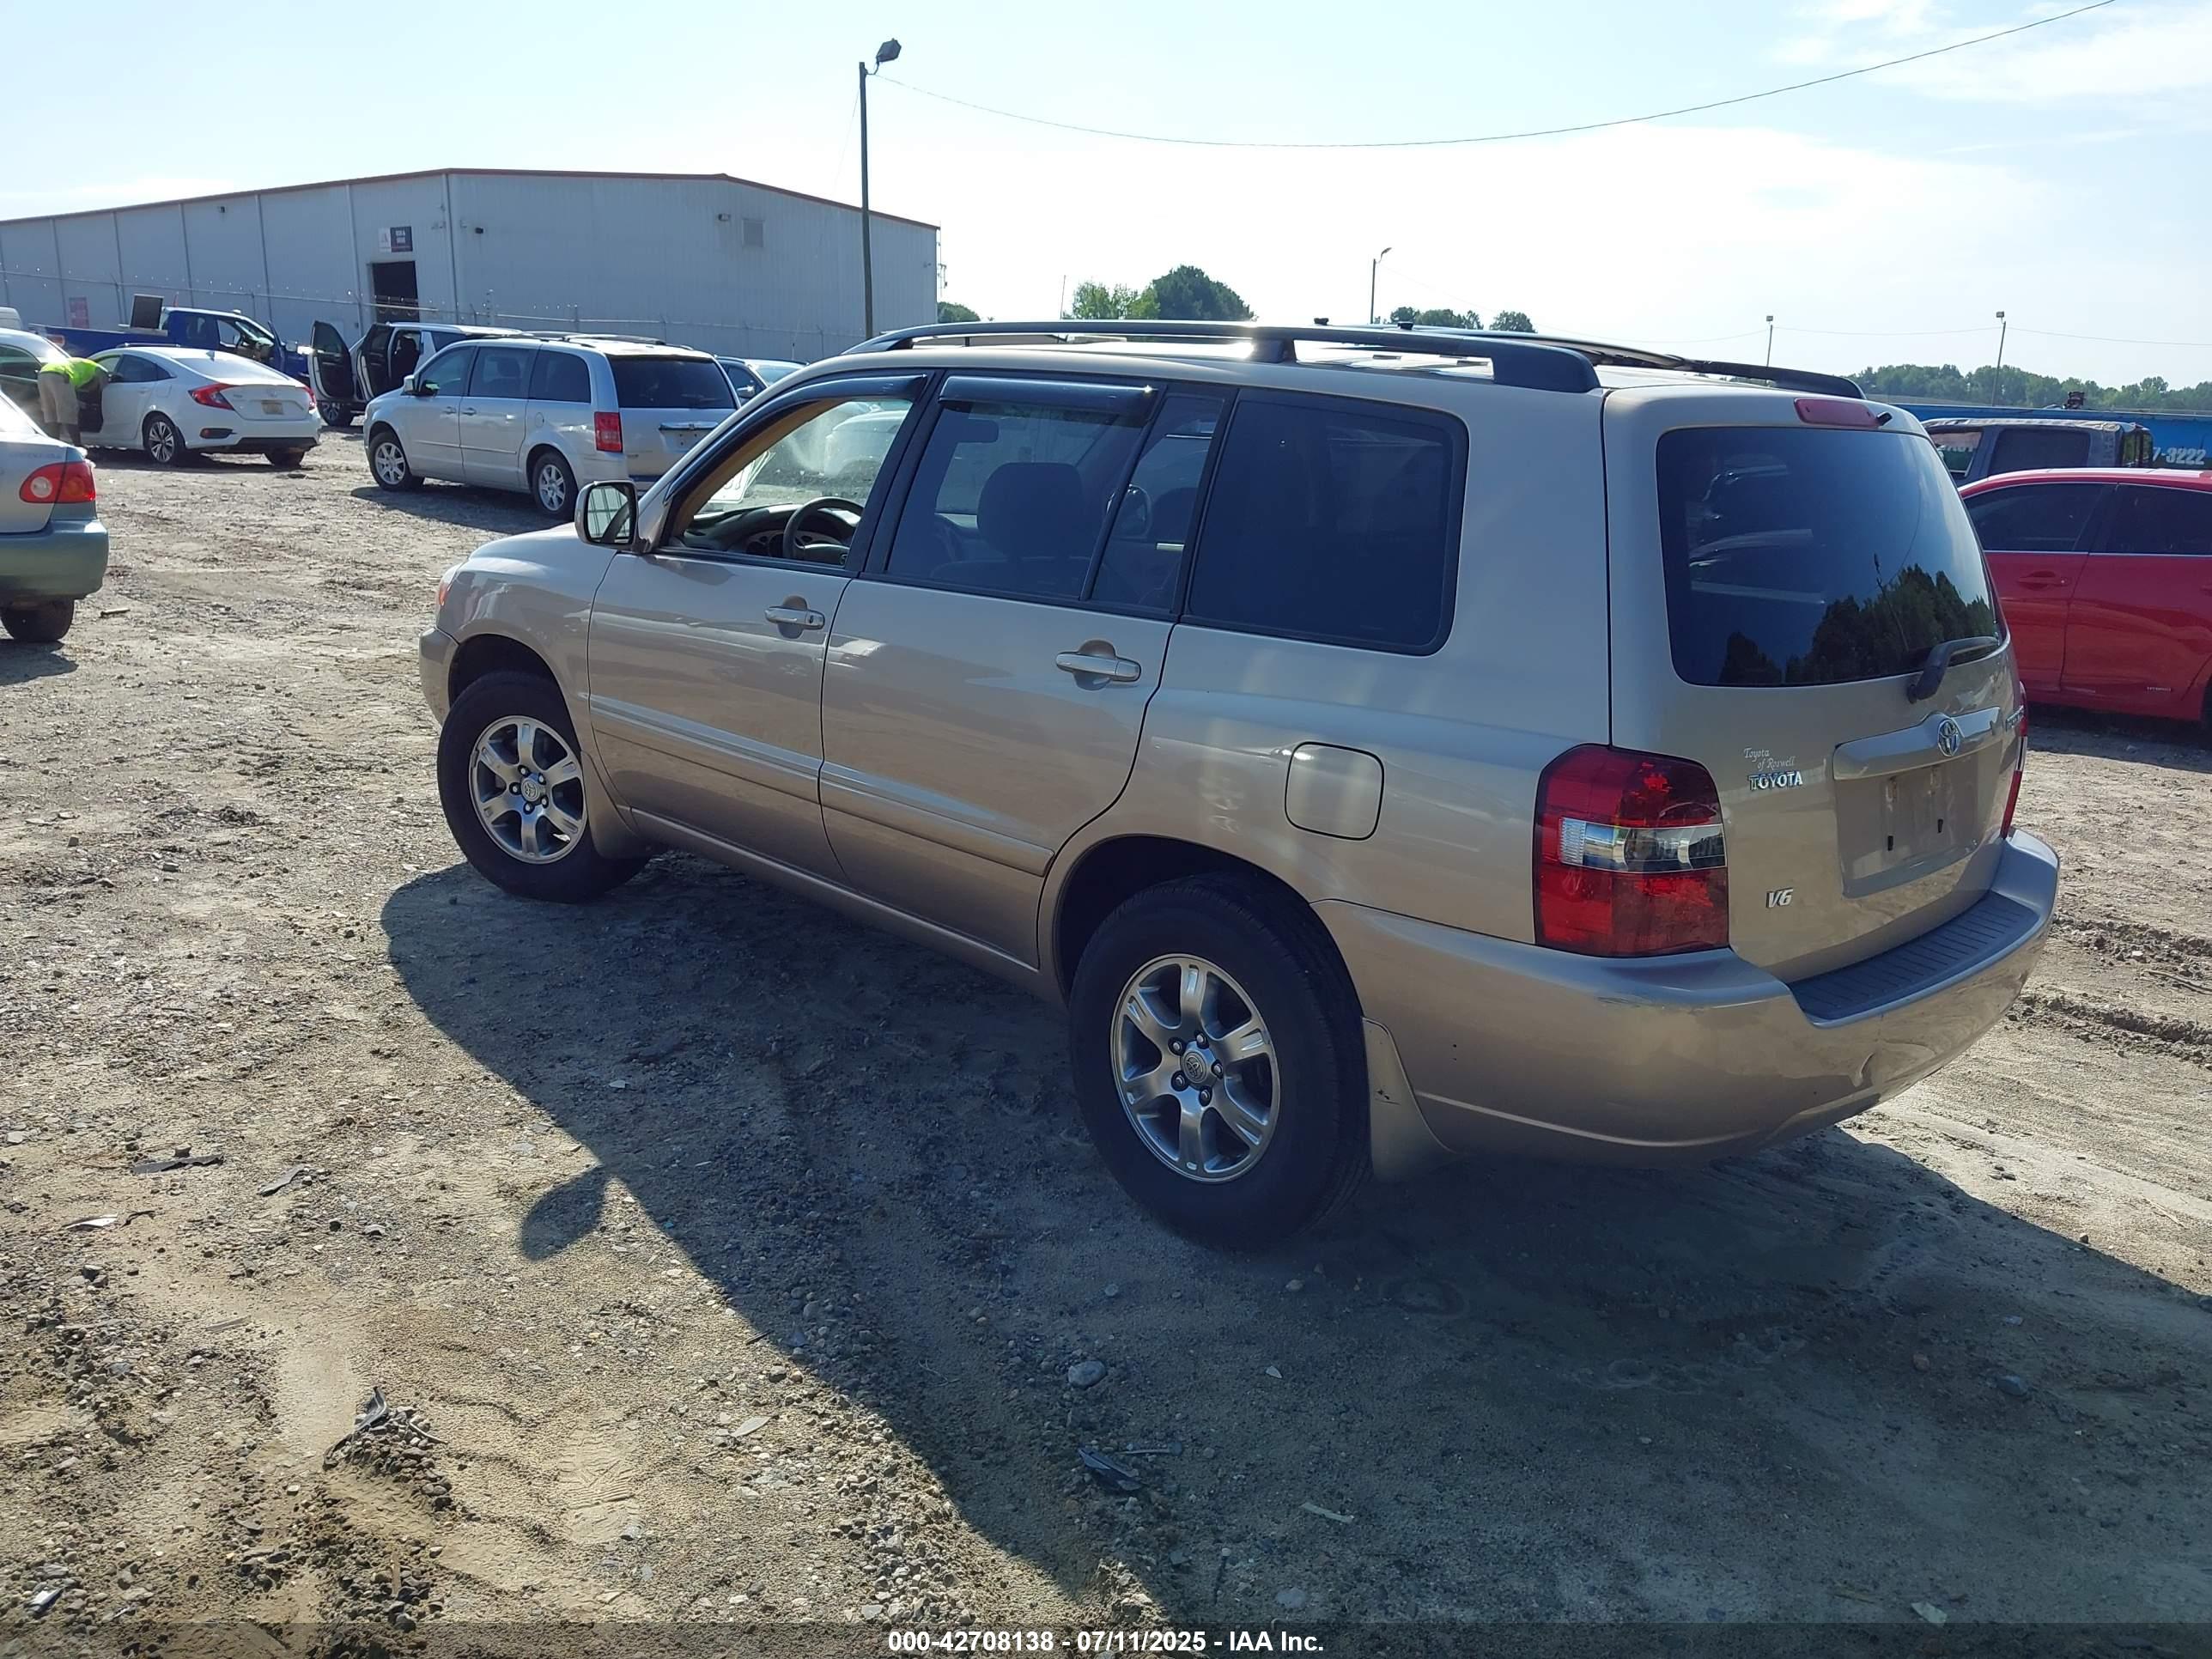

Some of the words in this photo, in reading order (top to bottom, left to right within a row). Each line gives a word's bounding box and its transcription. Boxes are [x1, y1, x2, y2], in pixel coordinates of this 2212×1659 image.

[1744, 747, 1769, 762] Toyota
[1757, 758, 1766, 771] of
[1747, 771, 1803, 790] TOYOTA
[1766, 886, 1794, 908] V6
